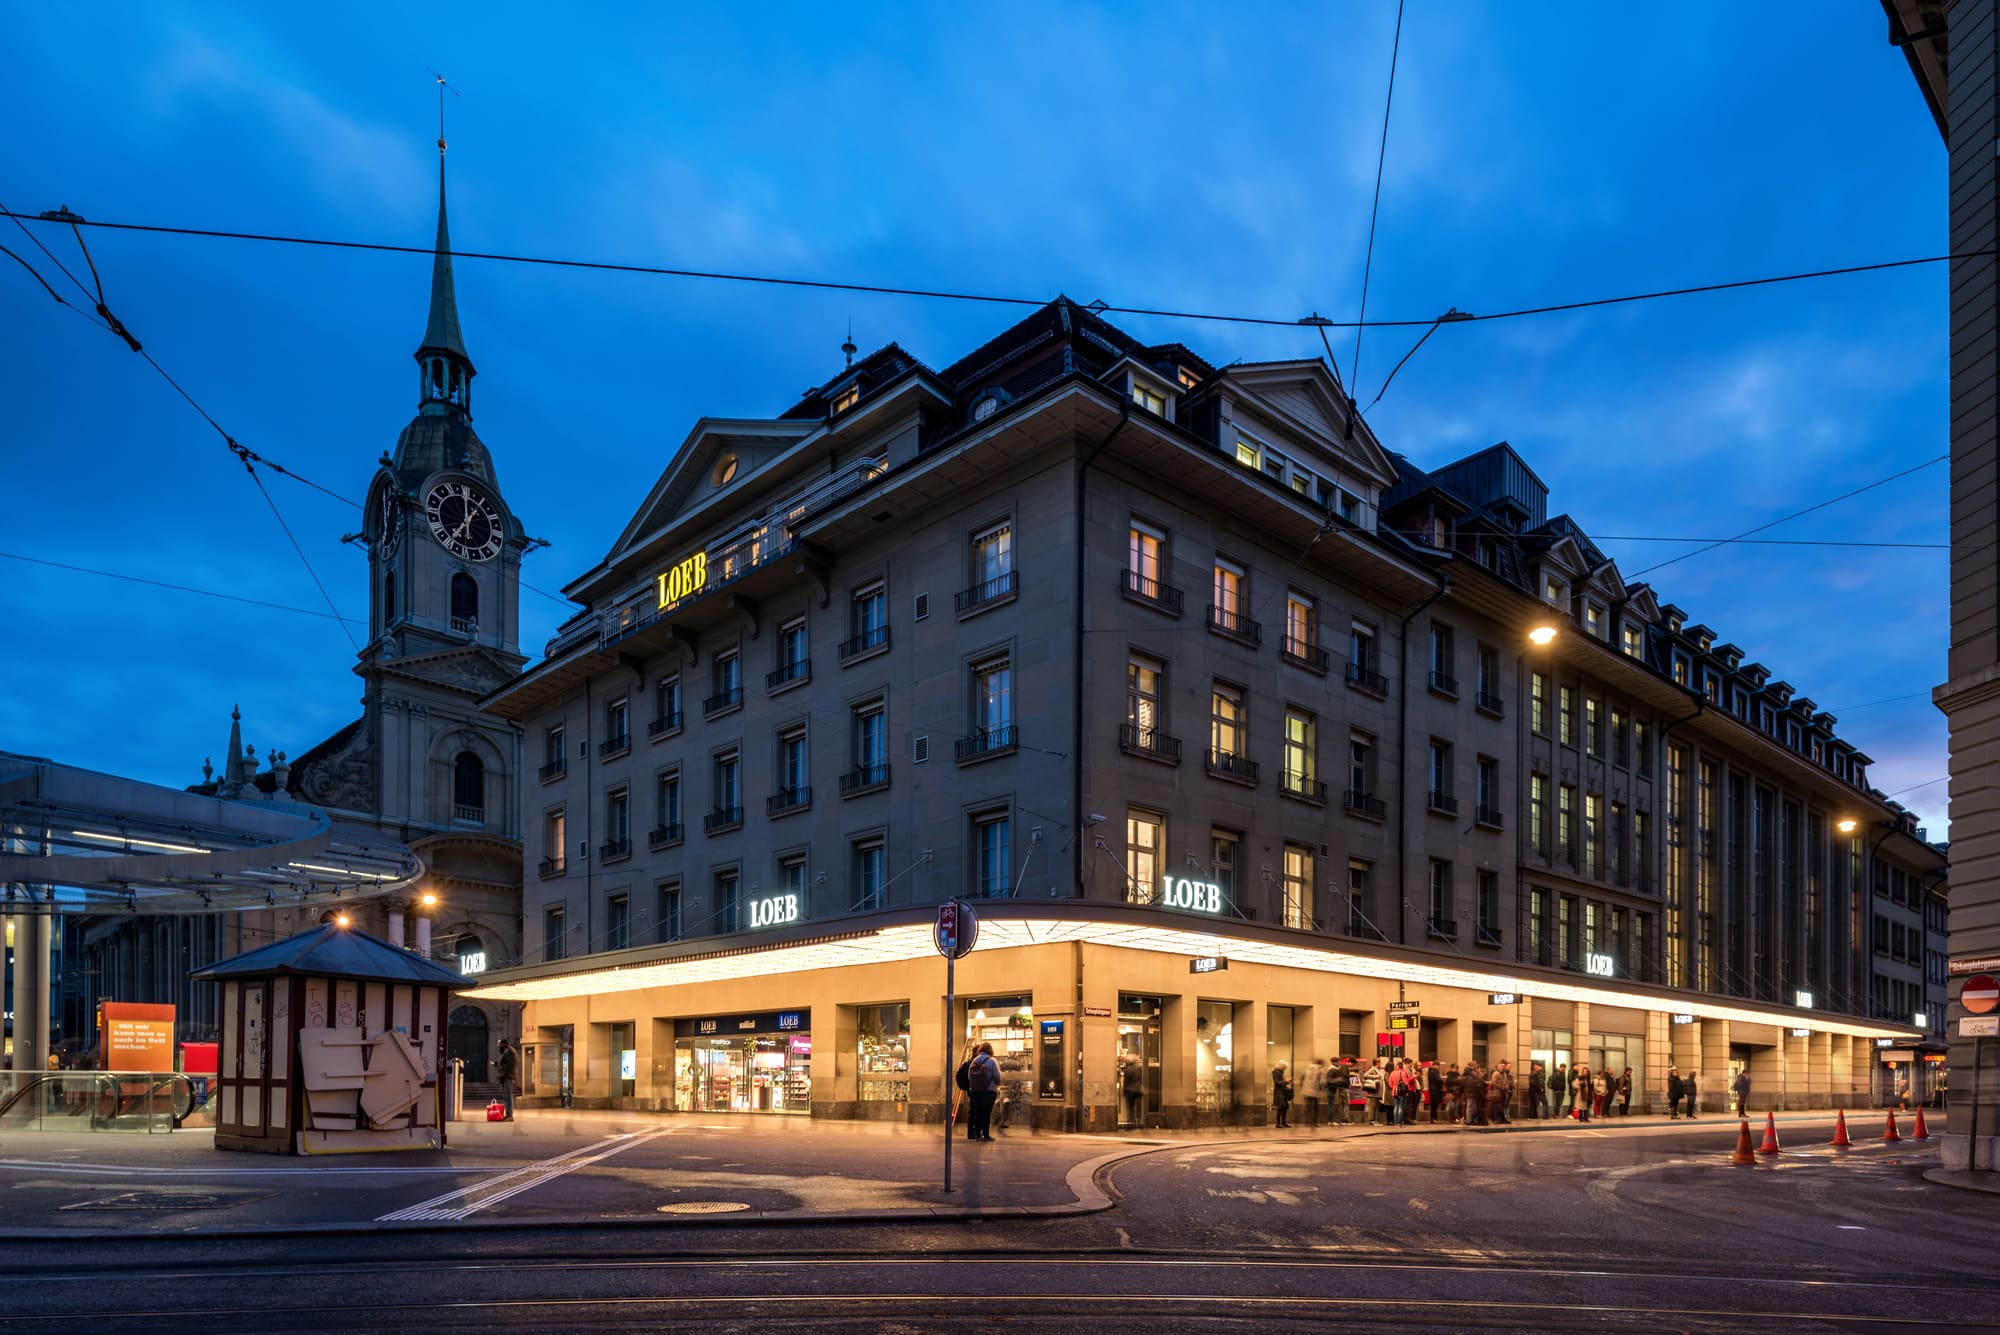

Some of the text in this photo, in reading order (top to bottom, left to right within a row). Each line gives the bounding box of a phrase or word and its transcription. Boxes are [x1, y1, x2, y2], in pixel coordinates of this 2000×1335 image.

[657, 552, 706, 609] LOEB
[1163, 876, 1221, 912] LOEB
[749, 894, 798, 928] LOEB
[461, 952, 486, 975] LOEB
[1196, 958, 1217, 970] LOEB
[1586, 953, 1613, 977] LOEB
[700, 1020, 717, 1031] LOEB
[780, 1015, 799, 1026] LOEB
